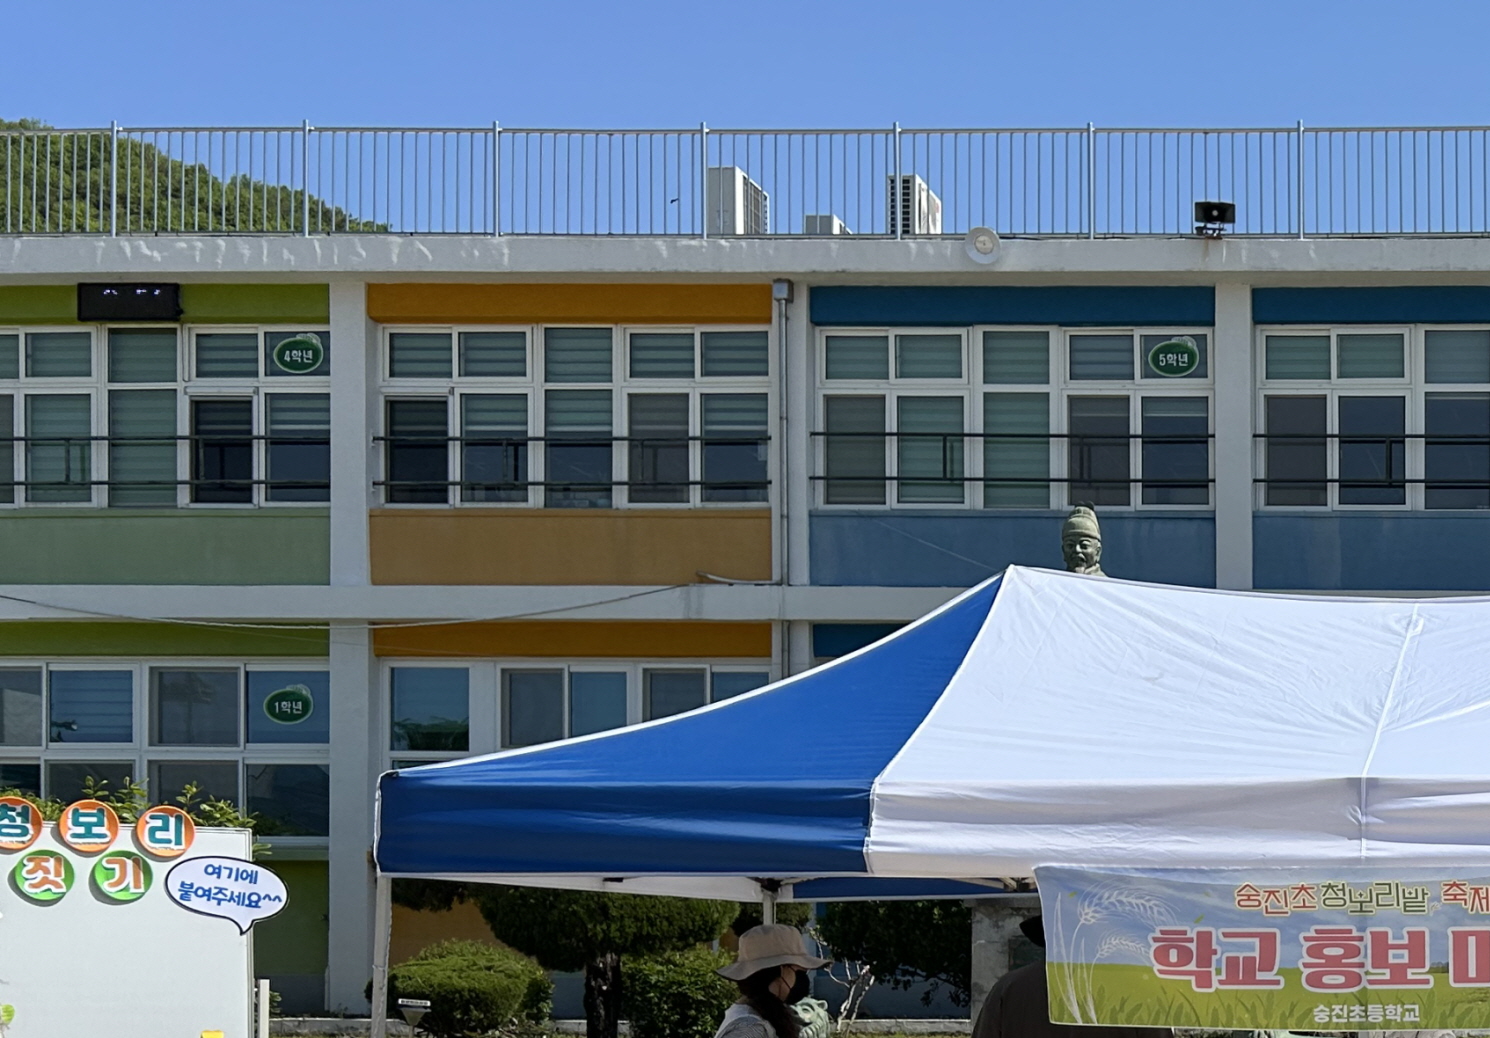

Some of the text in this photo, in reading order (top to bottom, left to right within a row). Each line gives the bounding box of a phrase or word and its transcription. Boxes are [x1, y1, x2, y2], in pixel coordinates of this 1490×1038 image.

[283, 349, 313, 363] 4학년
[1159, 353, 1188, 367] 5학년
[274, 701, 303, 714] 1학년
[23, 855, 146, 893] 짓기
[203, 863, 260, 885] 여기에
[1151, 926, 1281, 991] 학교
[1301, 925, 1434, 991] 홍보
[1312, 1002, 1421, 1024] 숭진초등학교
